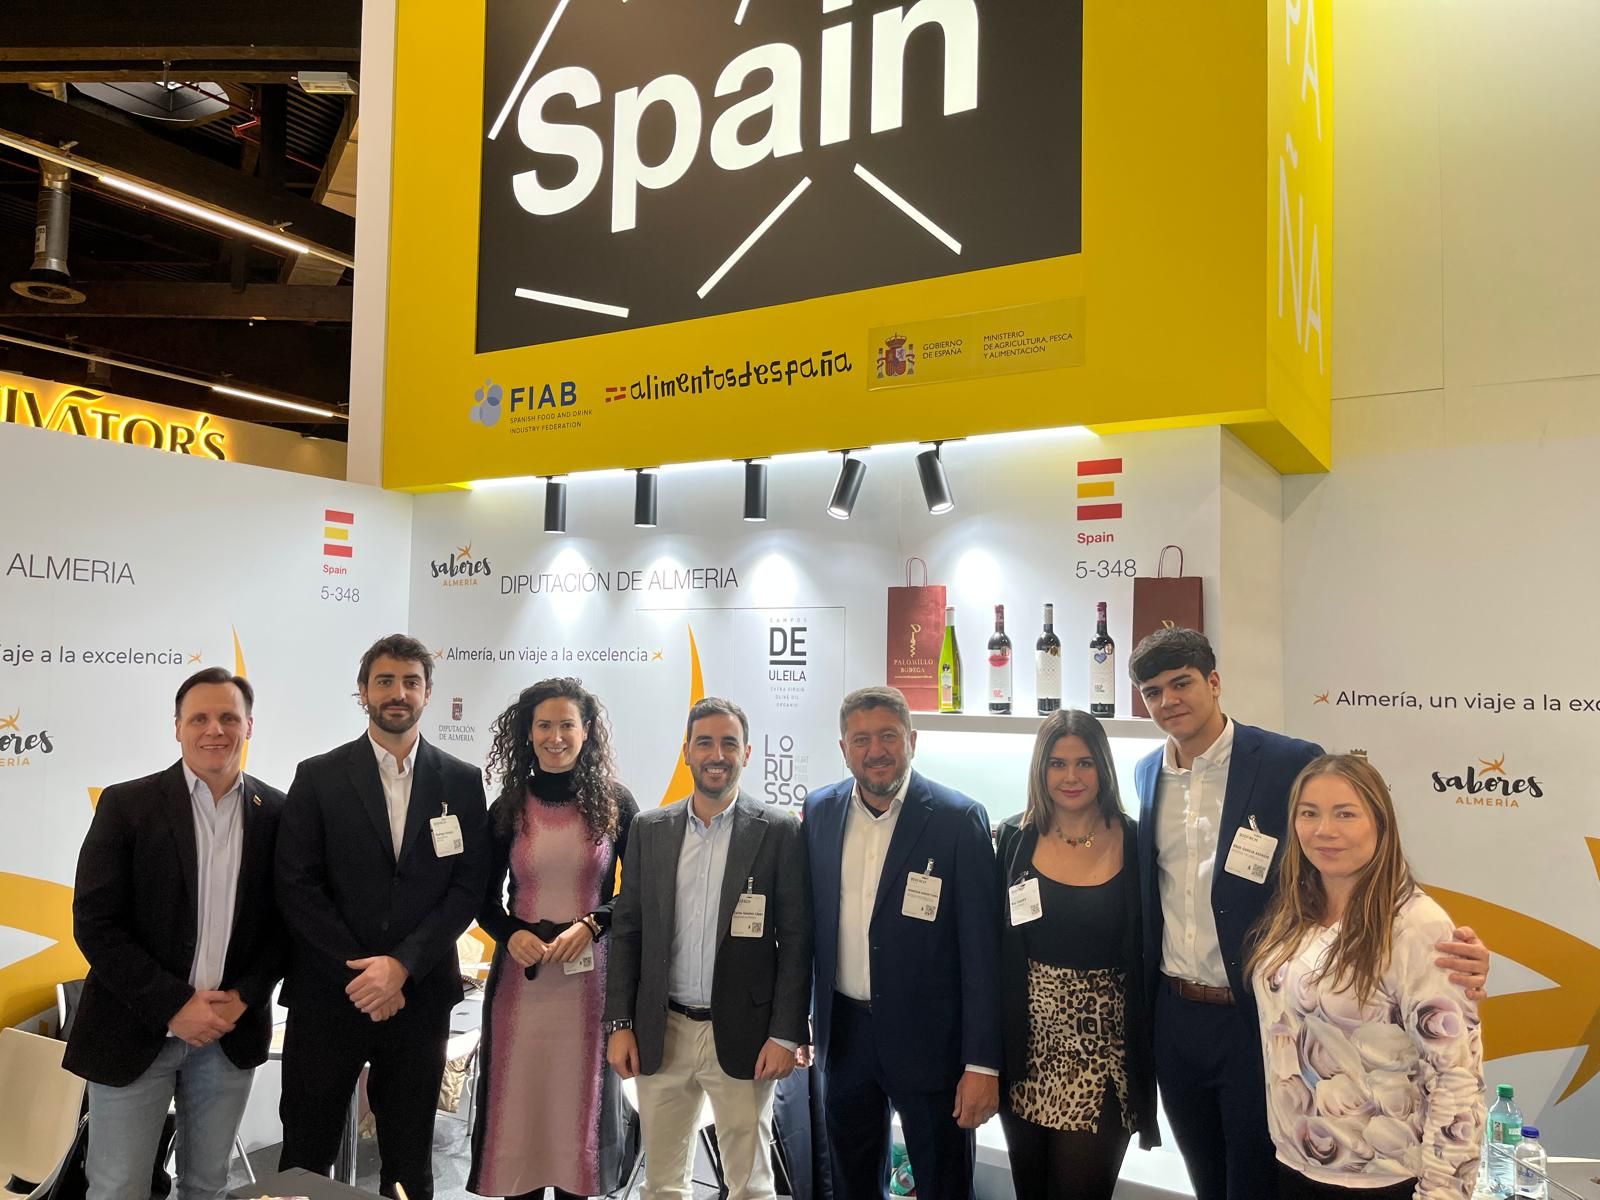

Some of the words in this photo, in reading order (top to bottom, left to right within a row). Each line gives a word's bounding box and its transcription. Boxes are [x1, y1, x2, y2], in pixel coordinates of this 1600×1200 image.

[983, 330, 1025, 342] MINISTERIO
[1049, 333, 1073, 342] PESCA
[922, 339, 963, 351] GOBIERNO
[989, 344, 1046, 359] ALIMENTACIÓN
[922, 352, 933, 360] DE
[934, 347, 962, 358] ESPAÑA
[510, 381, 577, 412] FIAB
[510, 415, 536, 424] SPANISH
[537, 412, 556, 420] FOOD
[557, 411, 572, 419] AND
[510, 426, 540, 434] INDUSTRY
[541, 421, 582, 431] FEDERATION
[1077, 532, 1115, 545] Spain
[6, 552, 135, 586] ALMERIA
[322, 563, 348, 576] Spain
[430, 553, 492, 578] sabores
[1075, 558, 1137, 579] 5-348
[501, 567, 611, 595] DIPUTACIÓN
[616, 570, 643, 592] DE
[648, 567, 739, 591] ALMERIA
[320, 585, 360, 603] 5-348
[769, 626, 808, 657] DE
[0, 643, 35, 667] aje
[41, 649, 52, 663] a
[59, 645, 76, 663] la
[82, 647, 183, 665] excelencia
[446, 646, 496, 662] Almería,
[499, 650, 515, 661] un
[518, 648, 548, 664] viaje
[551, 650, 558, 661] a
[562, 648, 573, 662] la
[576, 648, 649, 662] excelencia
[768, 669, 807, 682] ULEILA
[1336, 690, 1423, 709] Almería,
[1429, 695, 1458, 709] un
[1464, 692, 1516, 714] viaje
[1523, 698, 1535, 710] a
[1543, 694, 1561, 711] la
[439, 733, 448, 741] DE
[764, 757, 794, 782] RU
[1431, 766, 1543, 798] sabores
[1455, 796, 1520, 808] ALMERÍA
